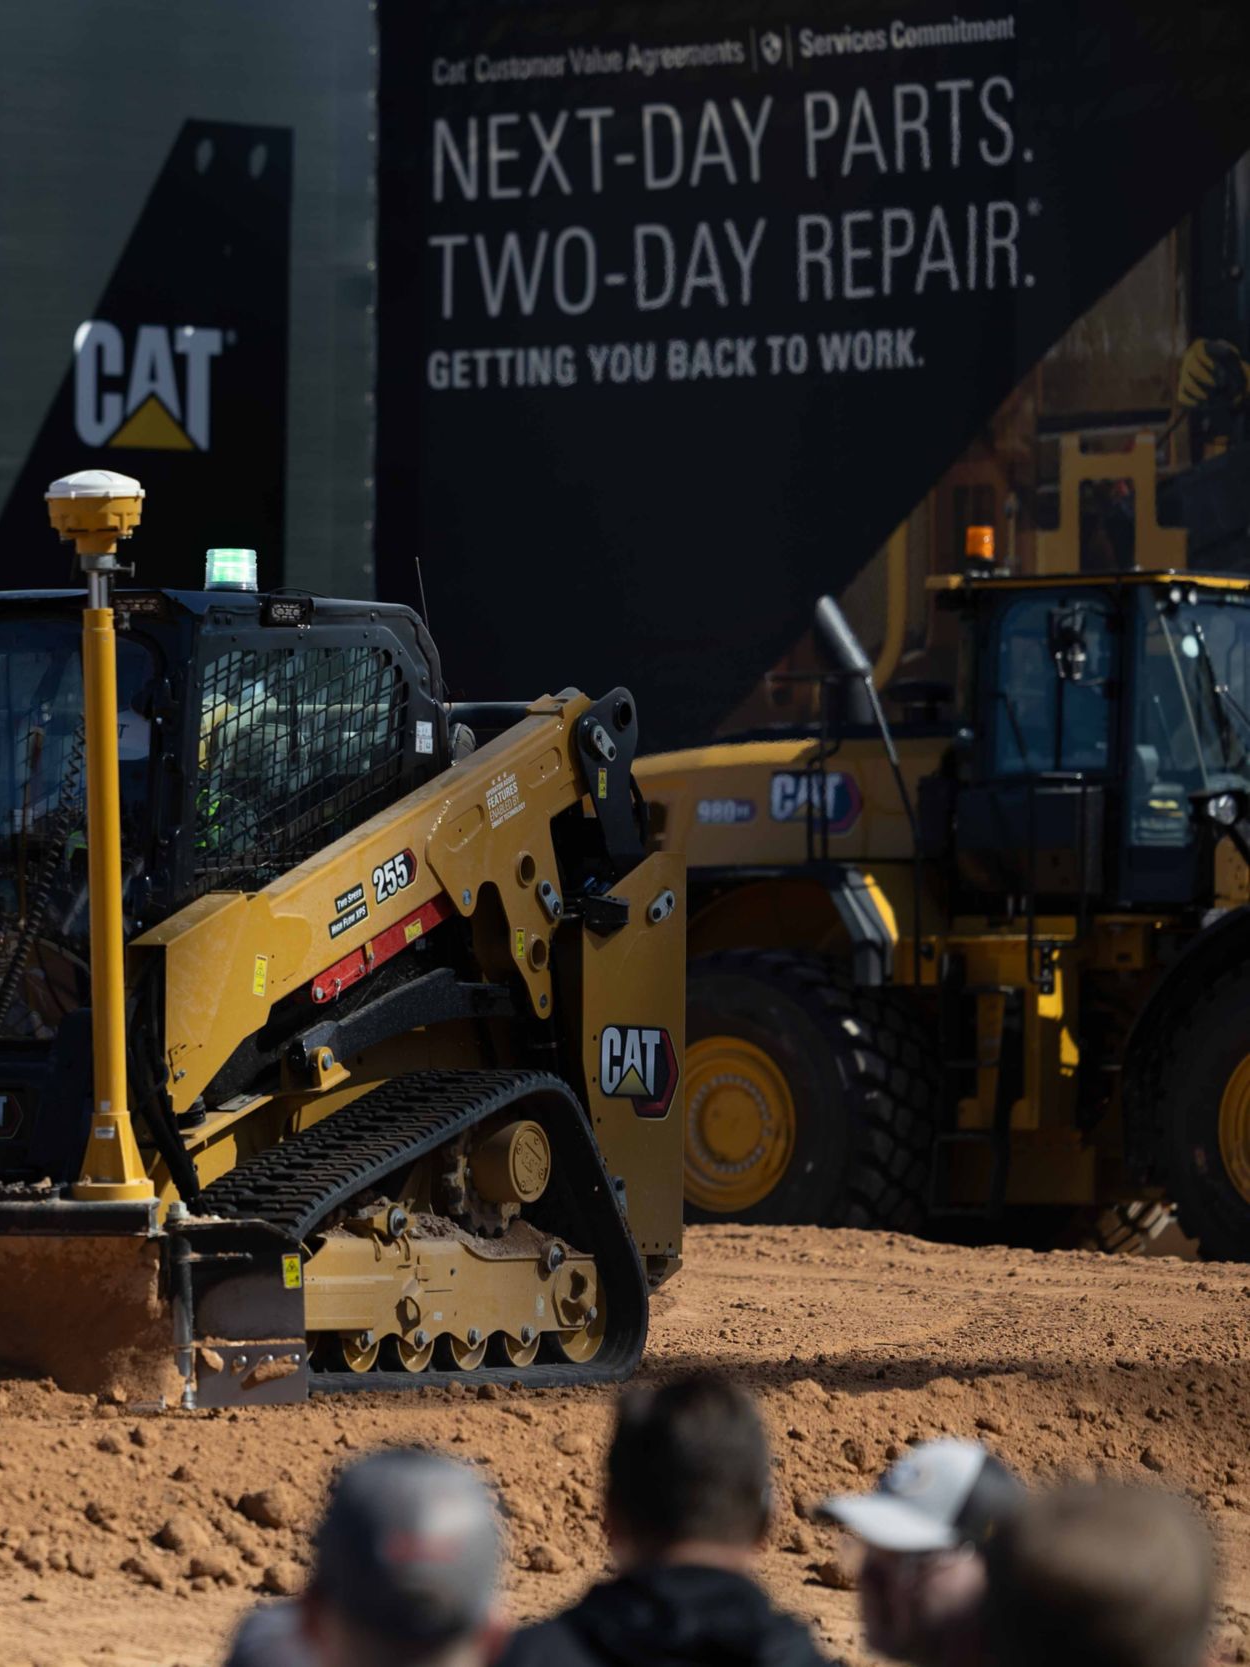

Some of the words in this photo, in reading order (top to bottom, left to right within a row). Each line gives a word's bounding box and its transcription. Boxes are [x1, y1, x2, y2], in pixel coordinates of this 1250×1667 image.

[567, 45, 623, 75] Value
[625, 38, 745, 77] Agreements
[799, 25, 888, 58] Services
[889, 14, 1016, 49] Commitment
[432, 97, 772, 202] NEXT-DAY
[804, 76, 1034, 179] PARTS.
[429, 218, 766, 319] TWO-DAY
[73, 319, 224, 452] CAT
[428, 346, 574, 389] GETTING
[589, 341, 655, 383] YOU
[668, 337, 756, 380] BACK
[767, 334, 808, 373] TO
[819, 329, 924, 371] WORK.
[487, 781, 518, 810] FEATURES
[771, 772, 843, 822] CAT
[373, 853, 408, 902] 255
[601, 1026, 661, 1096] CAT
